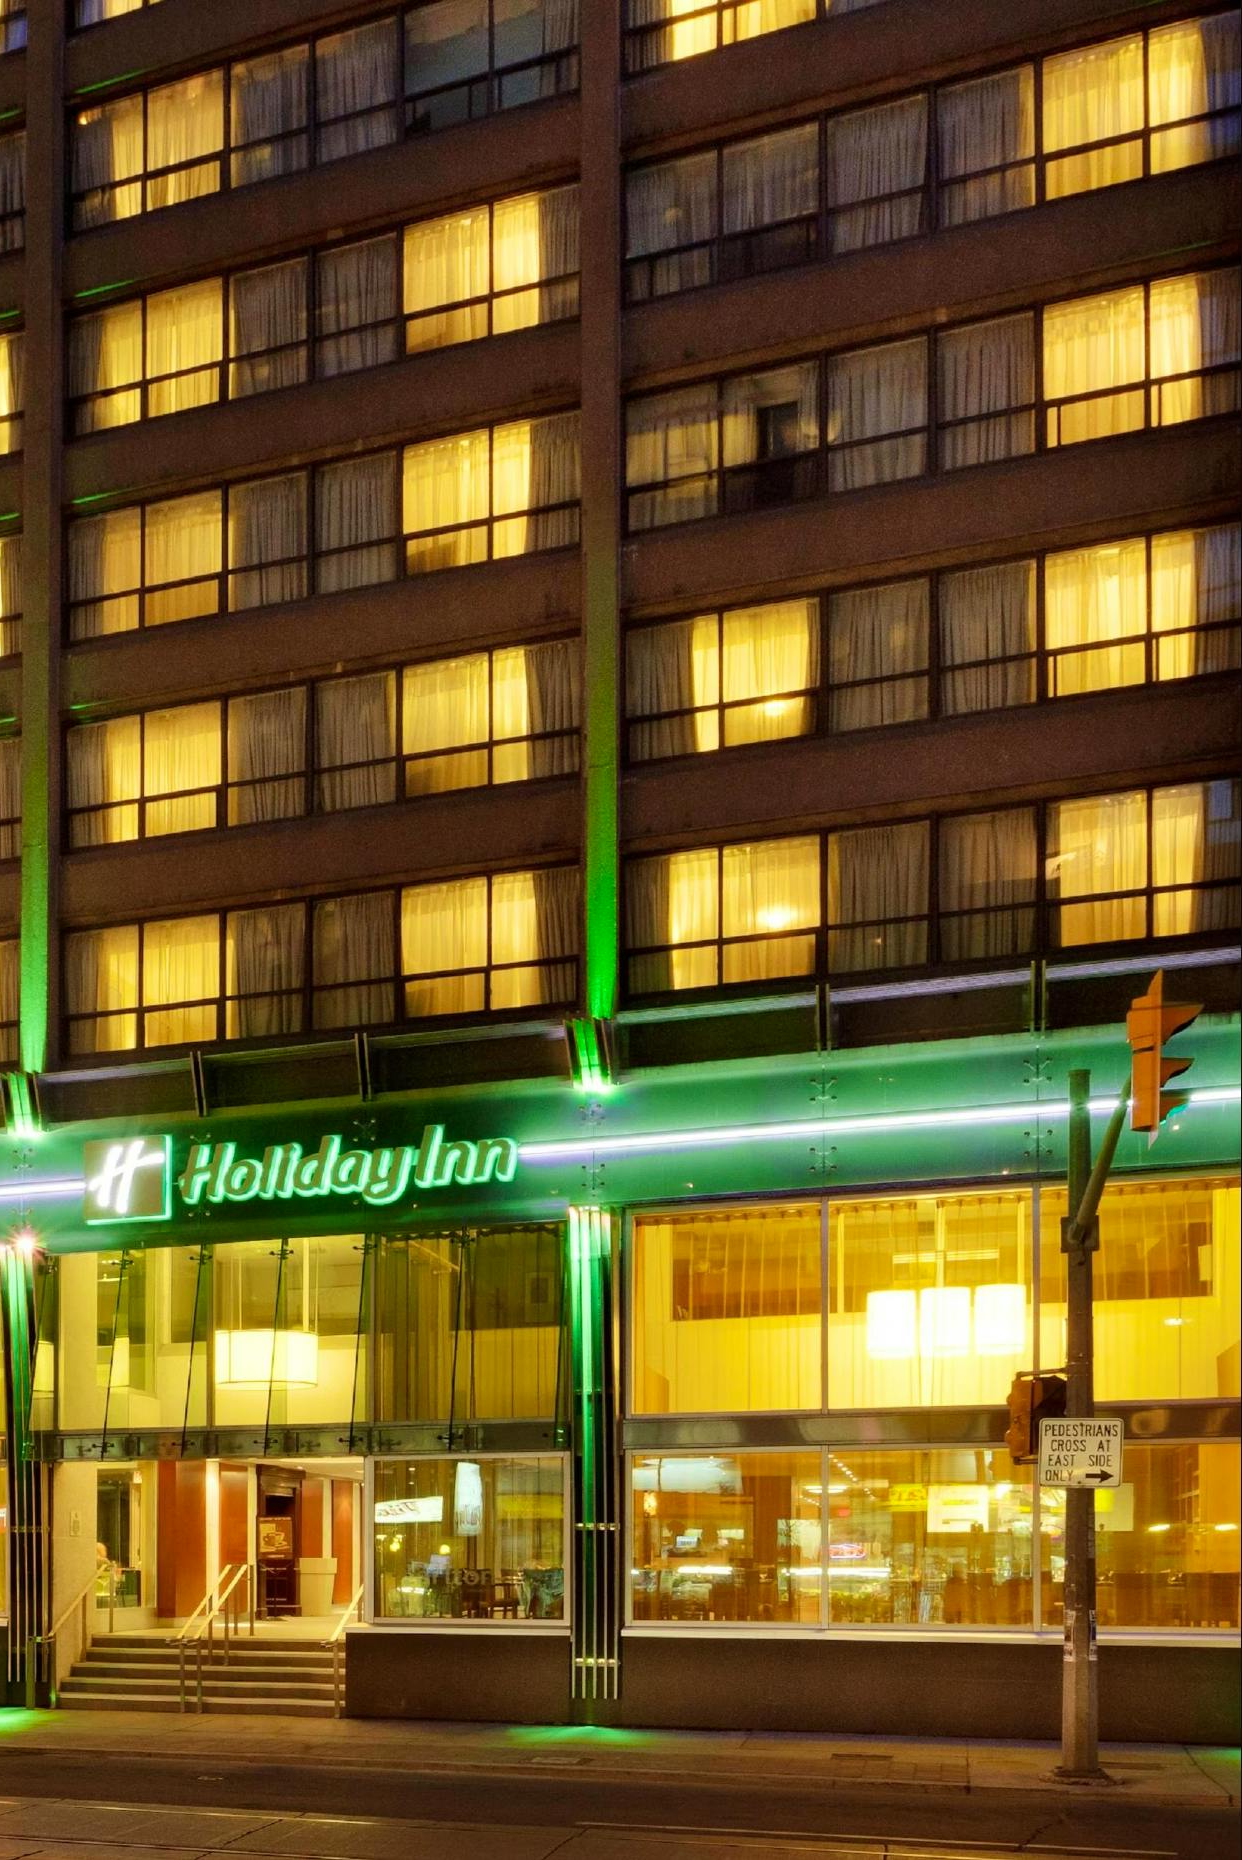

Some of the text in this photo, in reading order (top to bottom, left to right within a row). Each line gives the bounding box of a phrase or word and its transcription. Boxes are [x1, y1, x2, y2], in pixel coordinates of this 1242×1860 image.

[178, 1134, 415, 1206] Holiday
[413, 1124, 519, 1189] Inn
[1044, 1424, 1119, 1437] PEDESTRIANS
[1050, 1439, 1111, 1452] CROSS AT
[1047, 1454, 1113, 1467] EAST SIDE
[1045, 1469, 1074, 1482] ONLY
